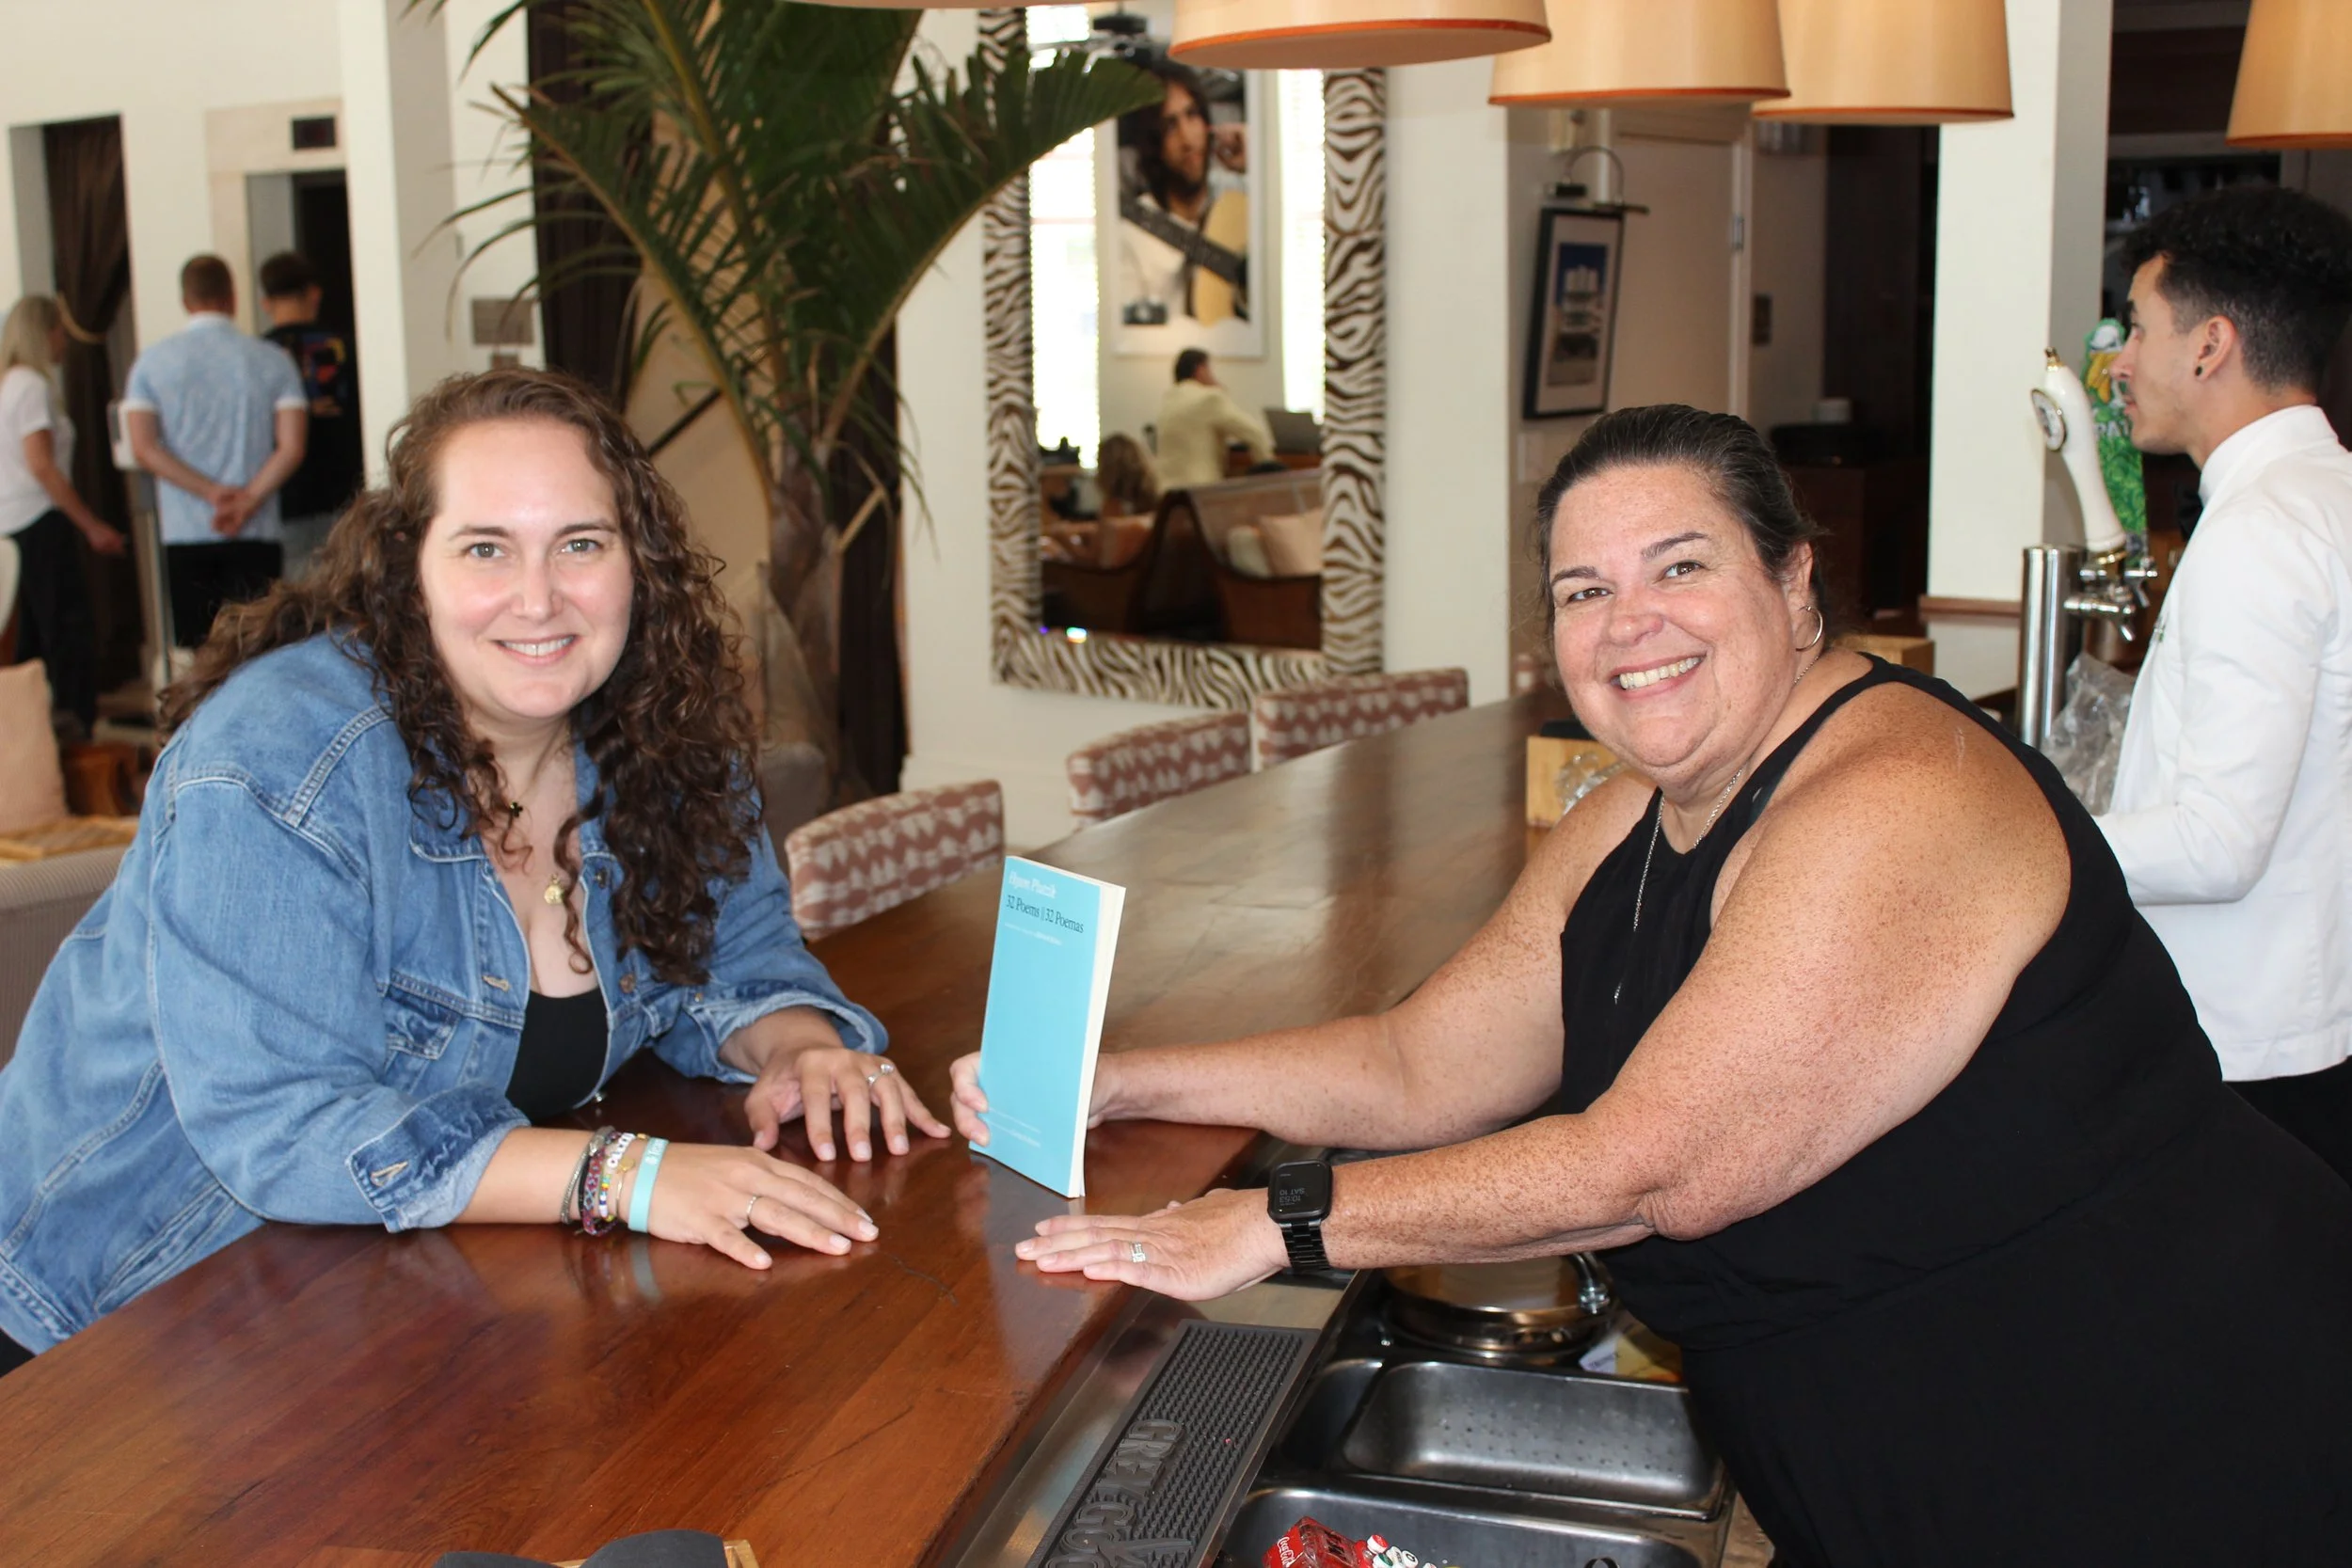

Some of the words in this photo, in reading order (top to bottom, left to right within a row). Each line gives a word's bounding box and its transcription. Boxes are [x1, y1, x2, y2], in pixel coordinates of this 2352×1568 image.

[1007, 895, 1015, 909] 32
[1016, 897, 1041, 918] Poems
[1045, 908, 1054, 923] 32
[1055, 911, 1084, 933] Poemas
[1096, 1418, 1184, 1500] GREY
